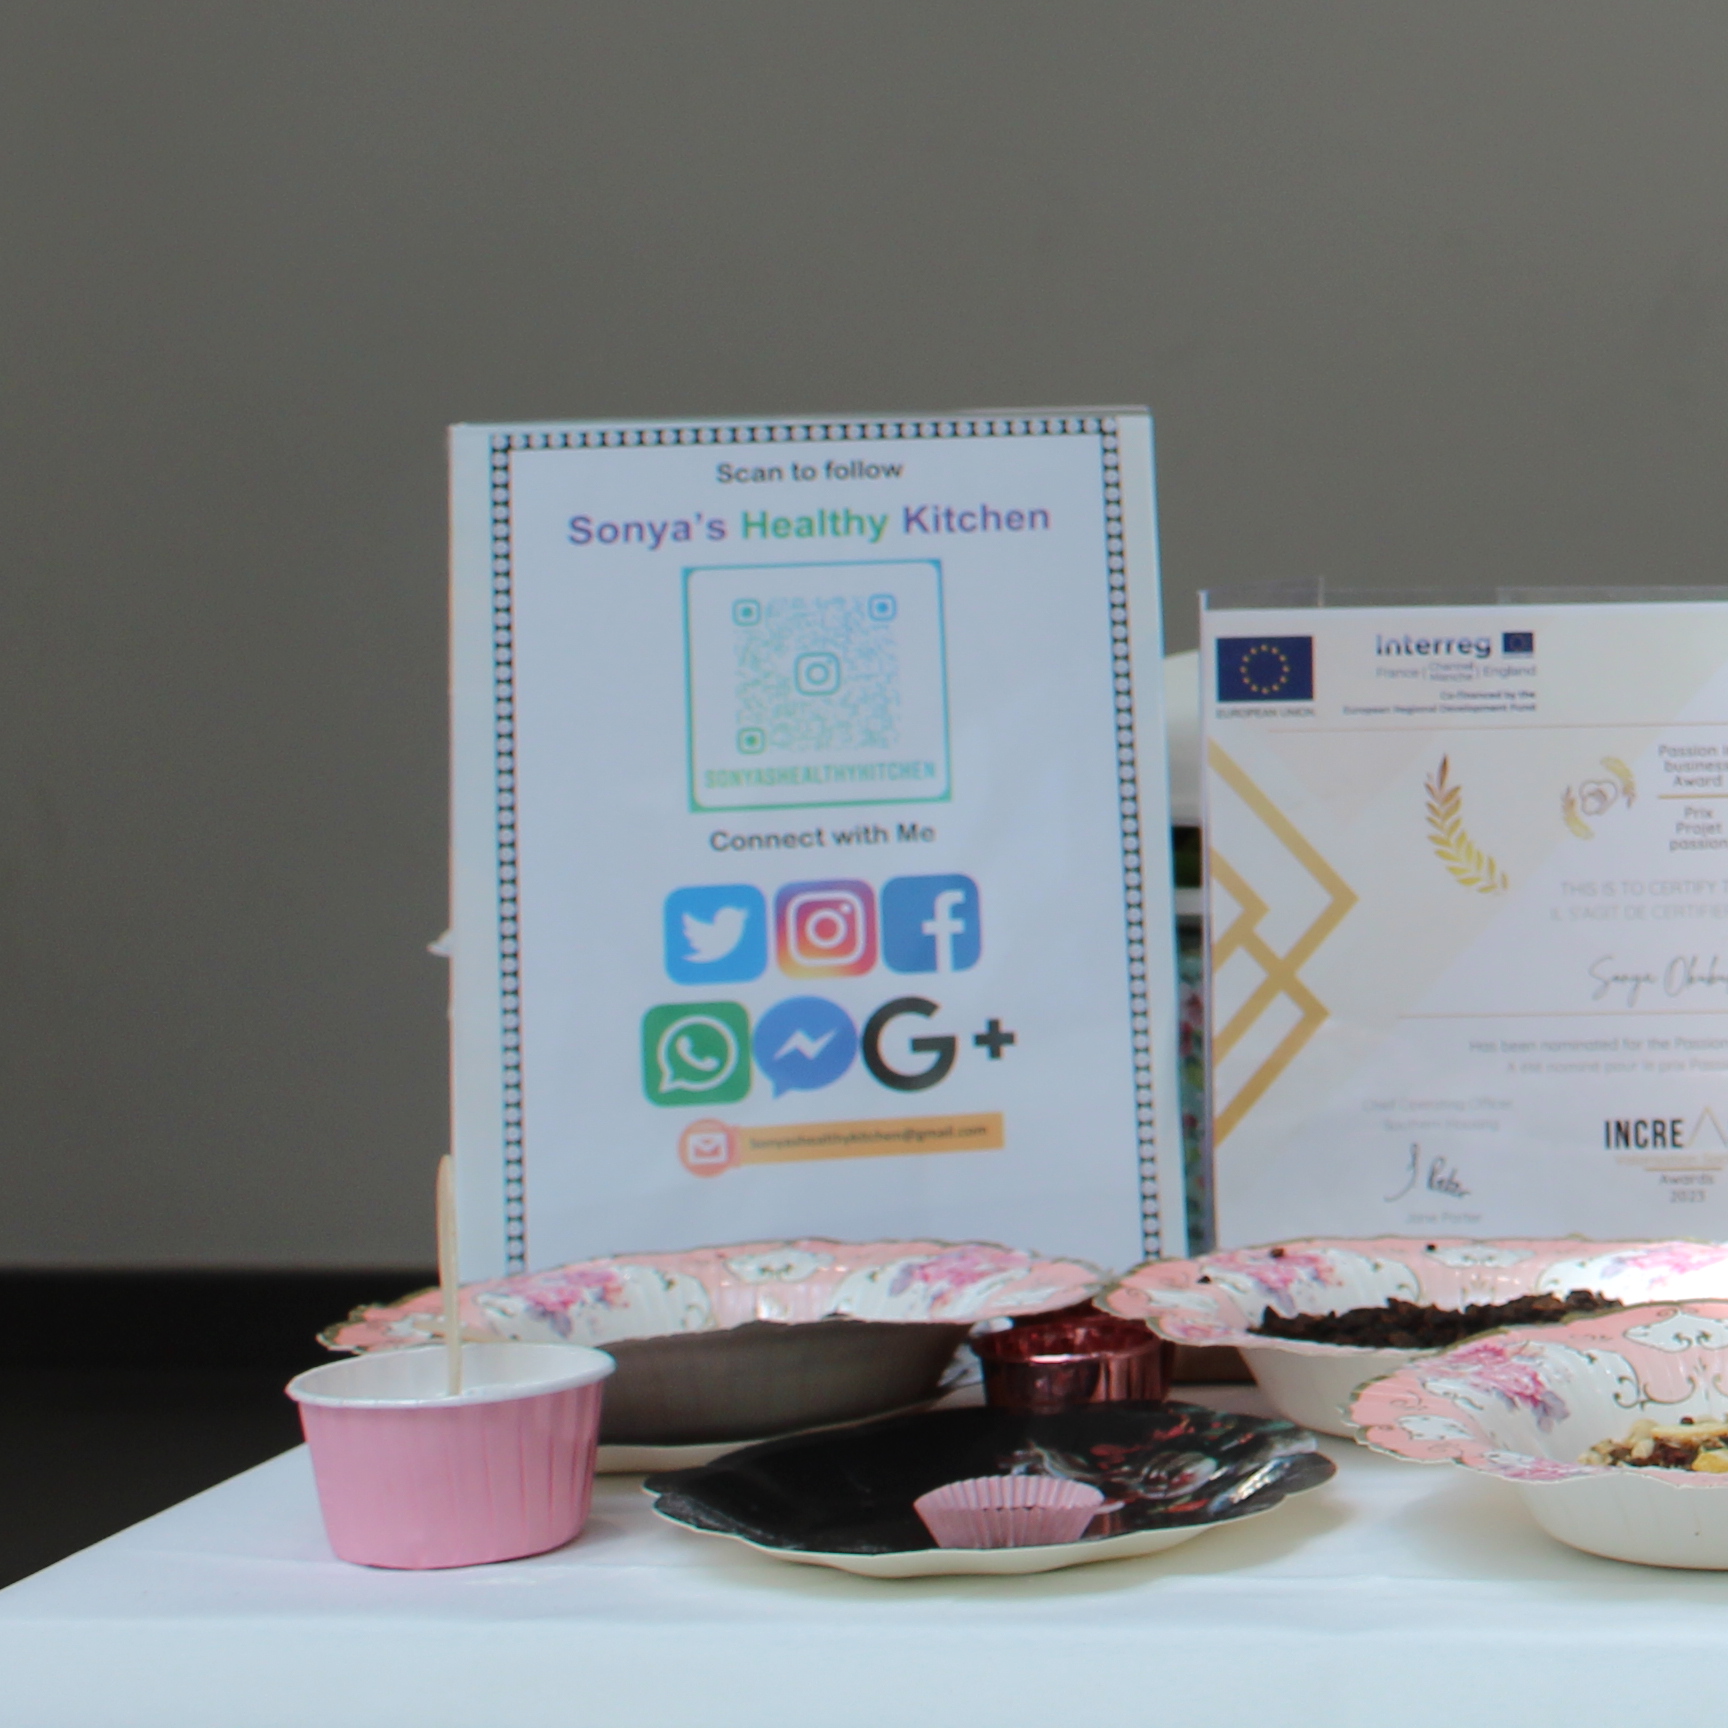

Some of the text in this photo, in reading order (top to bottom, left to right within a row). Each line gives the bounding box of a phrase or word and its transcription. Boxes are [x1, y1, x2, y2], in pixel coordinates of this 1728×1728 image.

[716, 458, 903, 484] Scan to follow
[567, 503, 1051, 552] Sonya's Healthy Kitchen
[1375, 633, 1492, 659] Interreg
[1657, 744, 1718, 757] Passion
[1672, 774, 1724, 788] Award
[1683, 806, 1714, 819] Prix
[709, 821, 936, 853] Connect with Me
[1675, 821, 1723, 836] Projet
[1560, 880, 1599, 897] THIS
[1601, 880, 1616, 897] IS
[1621, 879, 1645, 896] TO
[1648, 878, 1718, 896] CERTIFY
